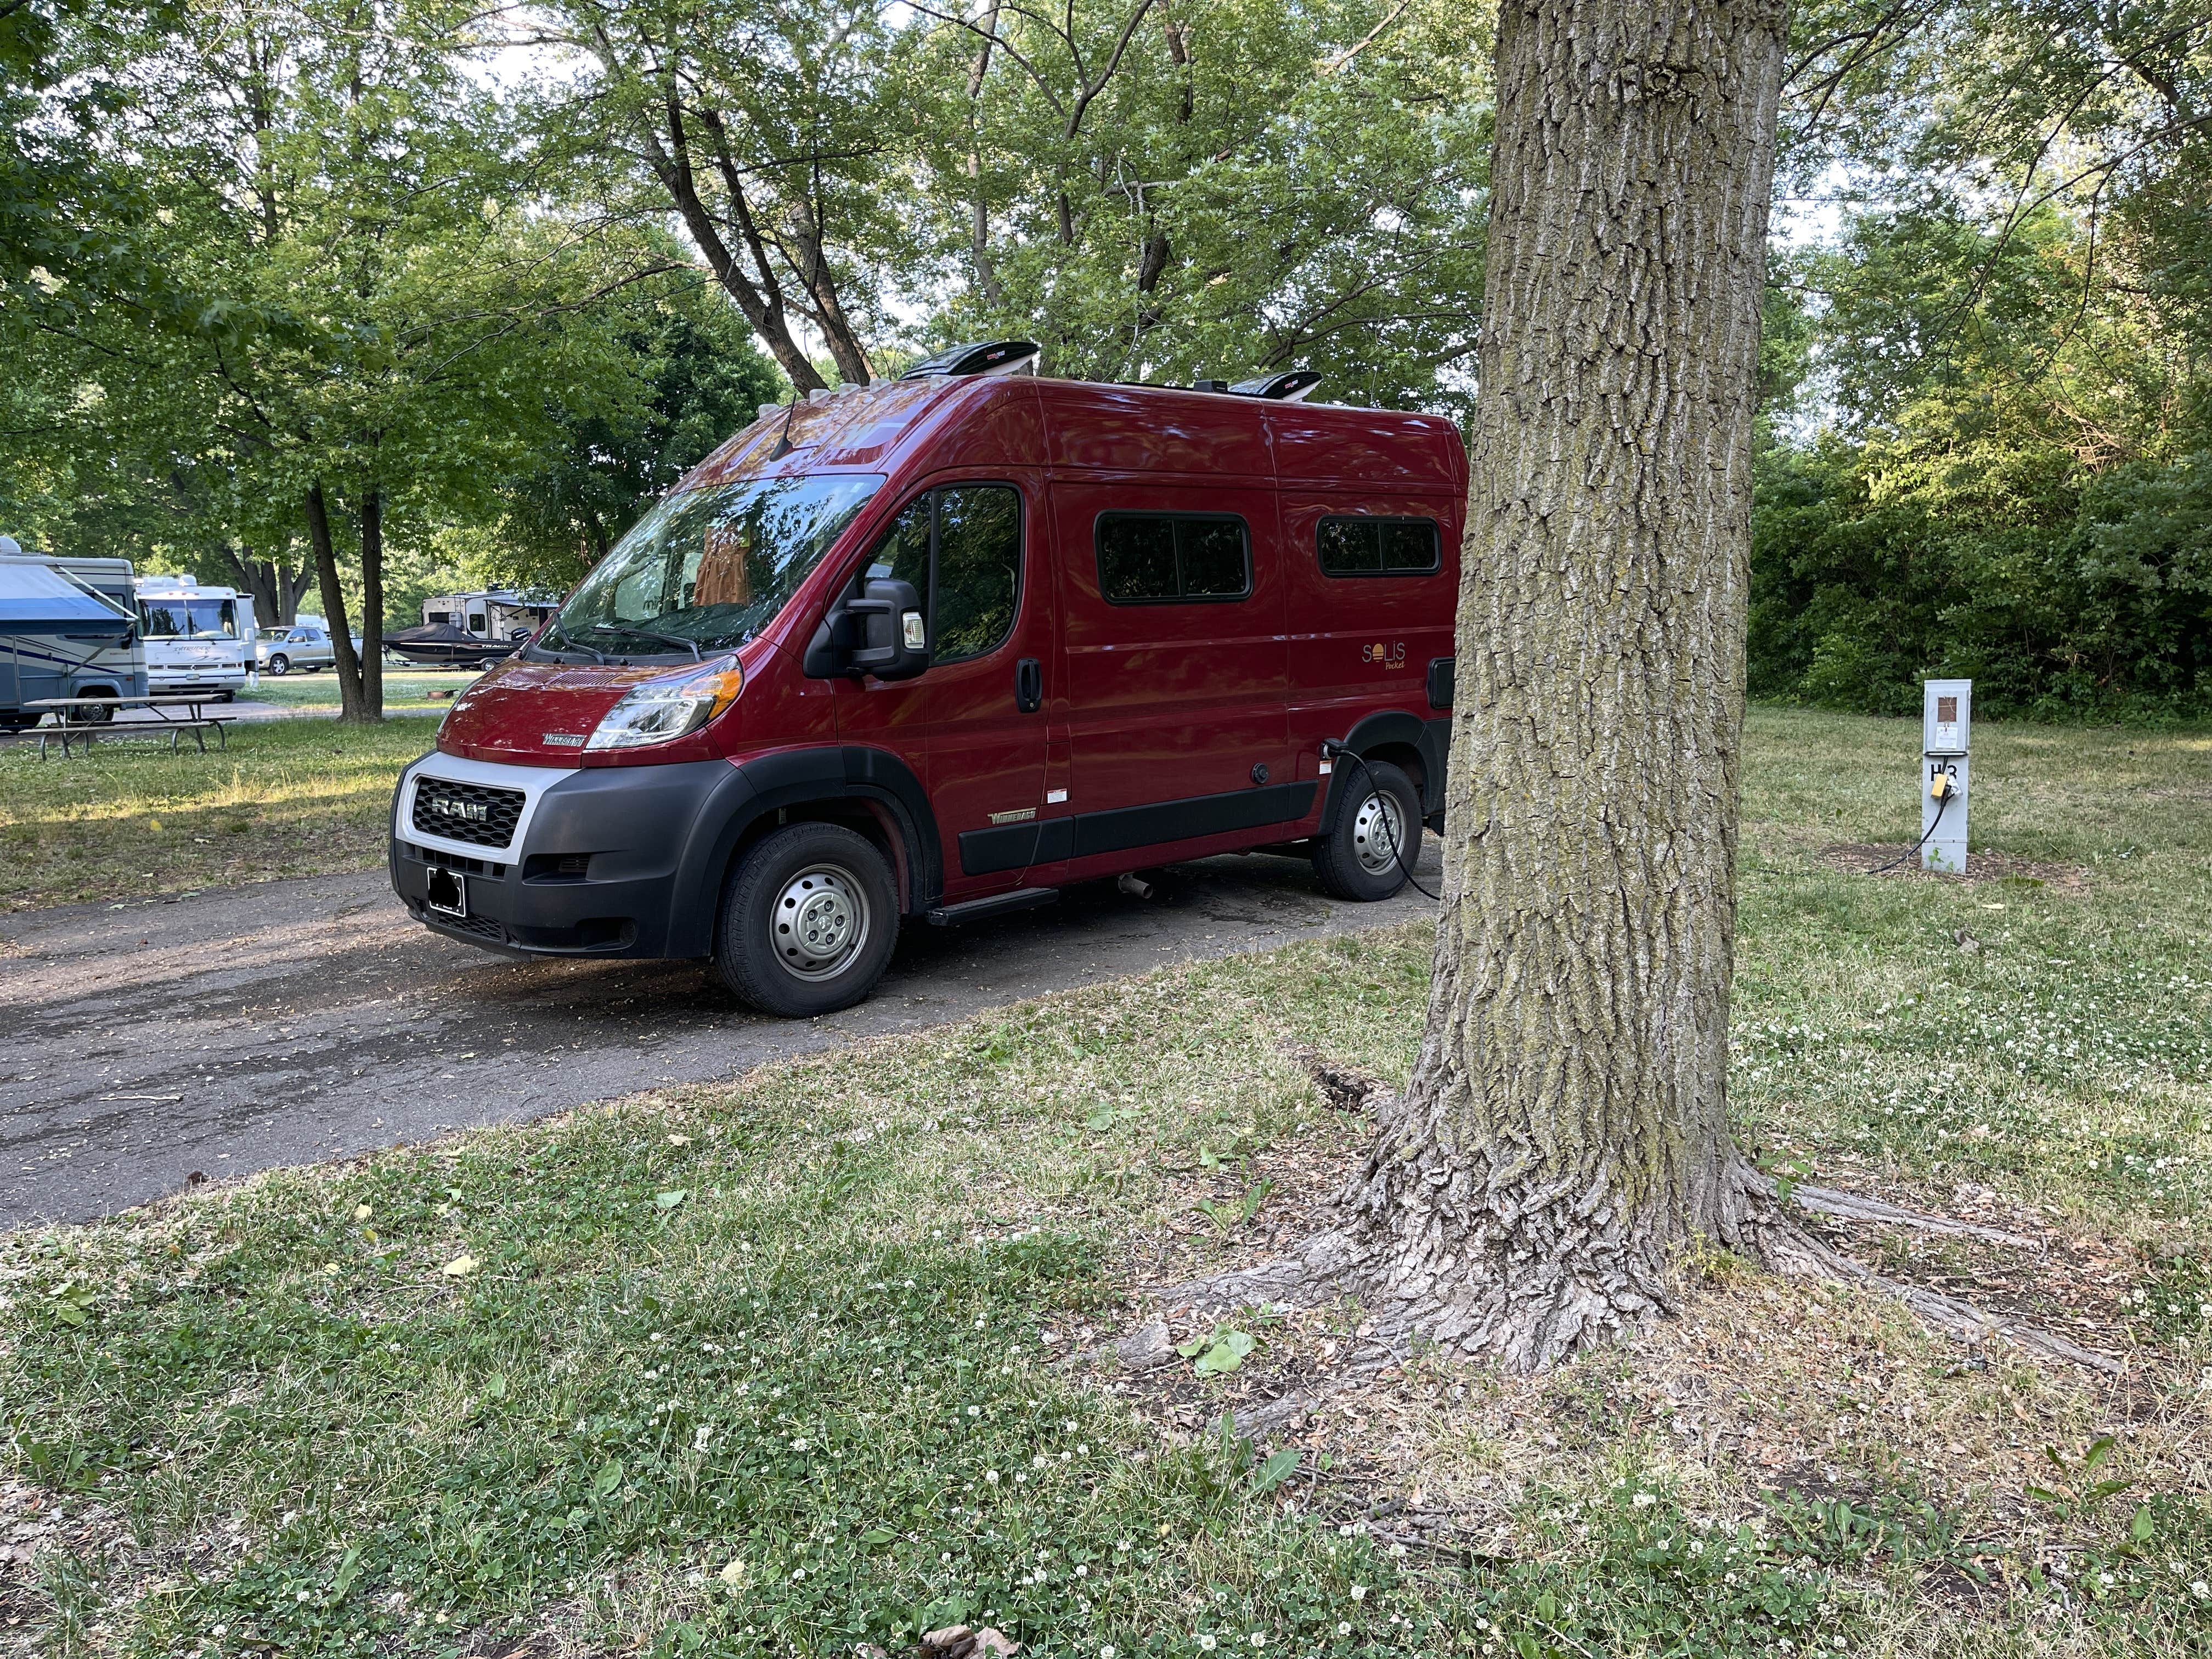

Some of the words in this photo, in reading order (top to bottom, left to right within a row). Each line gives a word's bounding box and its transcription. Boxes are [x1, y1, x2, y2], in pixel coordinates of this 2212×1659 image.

[1362, 641, 1406, 663] SOLIS
[1385, 661, 1405, 670] Pocket
[432, 798, 487, 821] RAM
